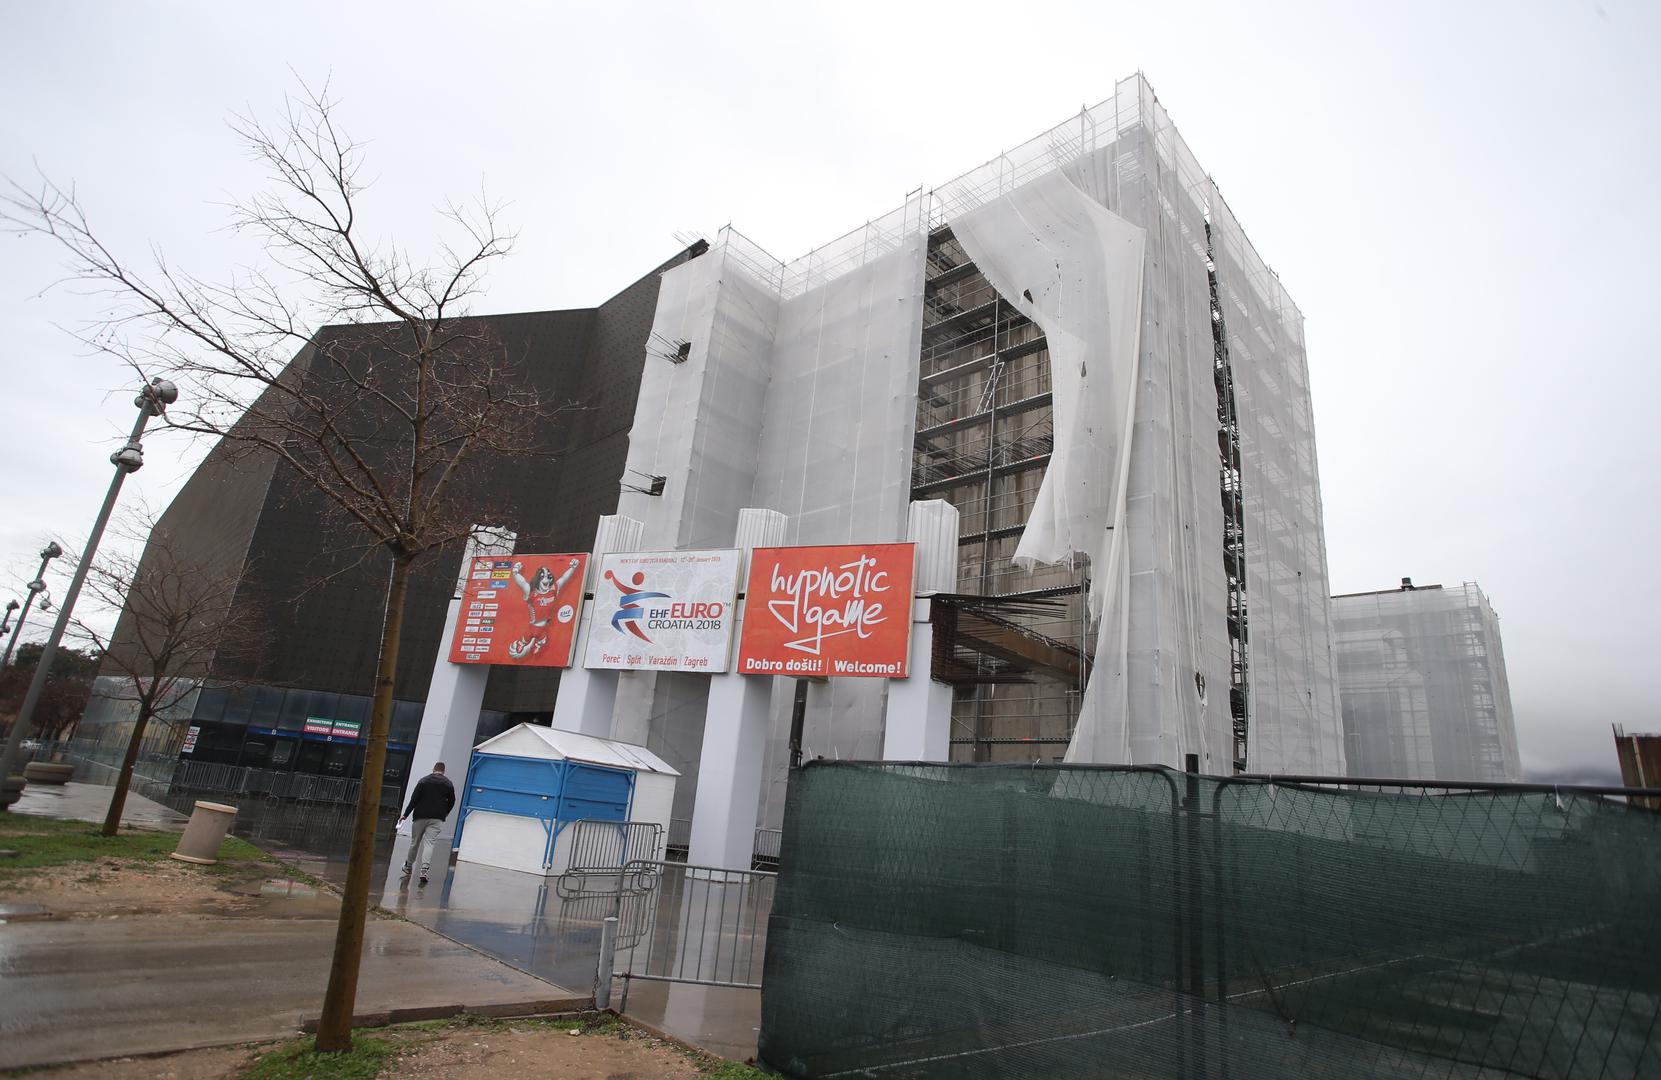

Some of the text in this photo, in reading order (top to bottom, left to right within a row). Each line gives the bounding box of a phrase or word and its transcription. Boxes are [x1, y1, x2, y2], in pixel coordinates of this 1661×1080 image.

[768, 554, 890, 633] hypnotic
[649, 609, 670, 618] EHF
[670, 602, 723, 619] EURO
[648, 620, 721, 629] CROATIA 2018
[784, 599, 888, 655] game
[627, 654, 641, 666] Split
[684, 656, 708, 668] Zagreb
[746, 658, 901, 673] Dobro došli! Welcome!
[306, 725, 359, 736] VISITORS ENTRANCE
